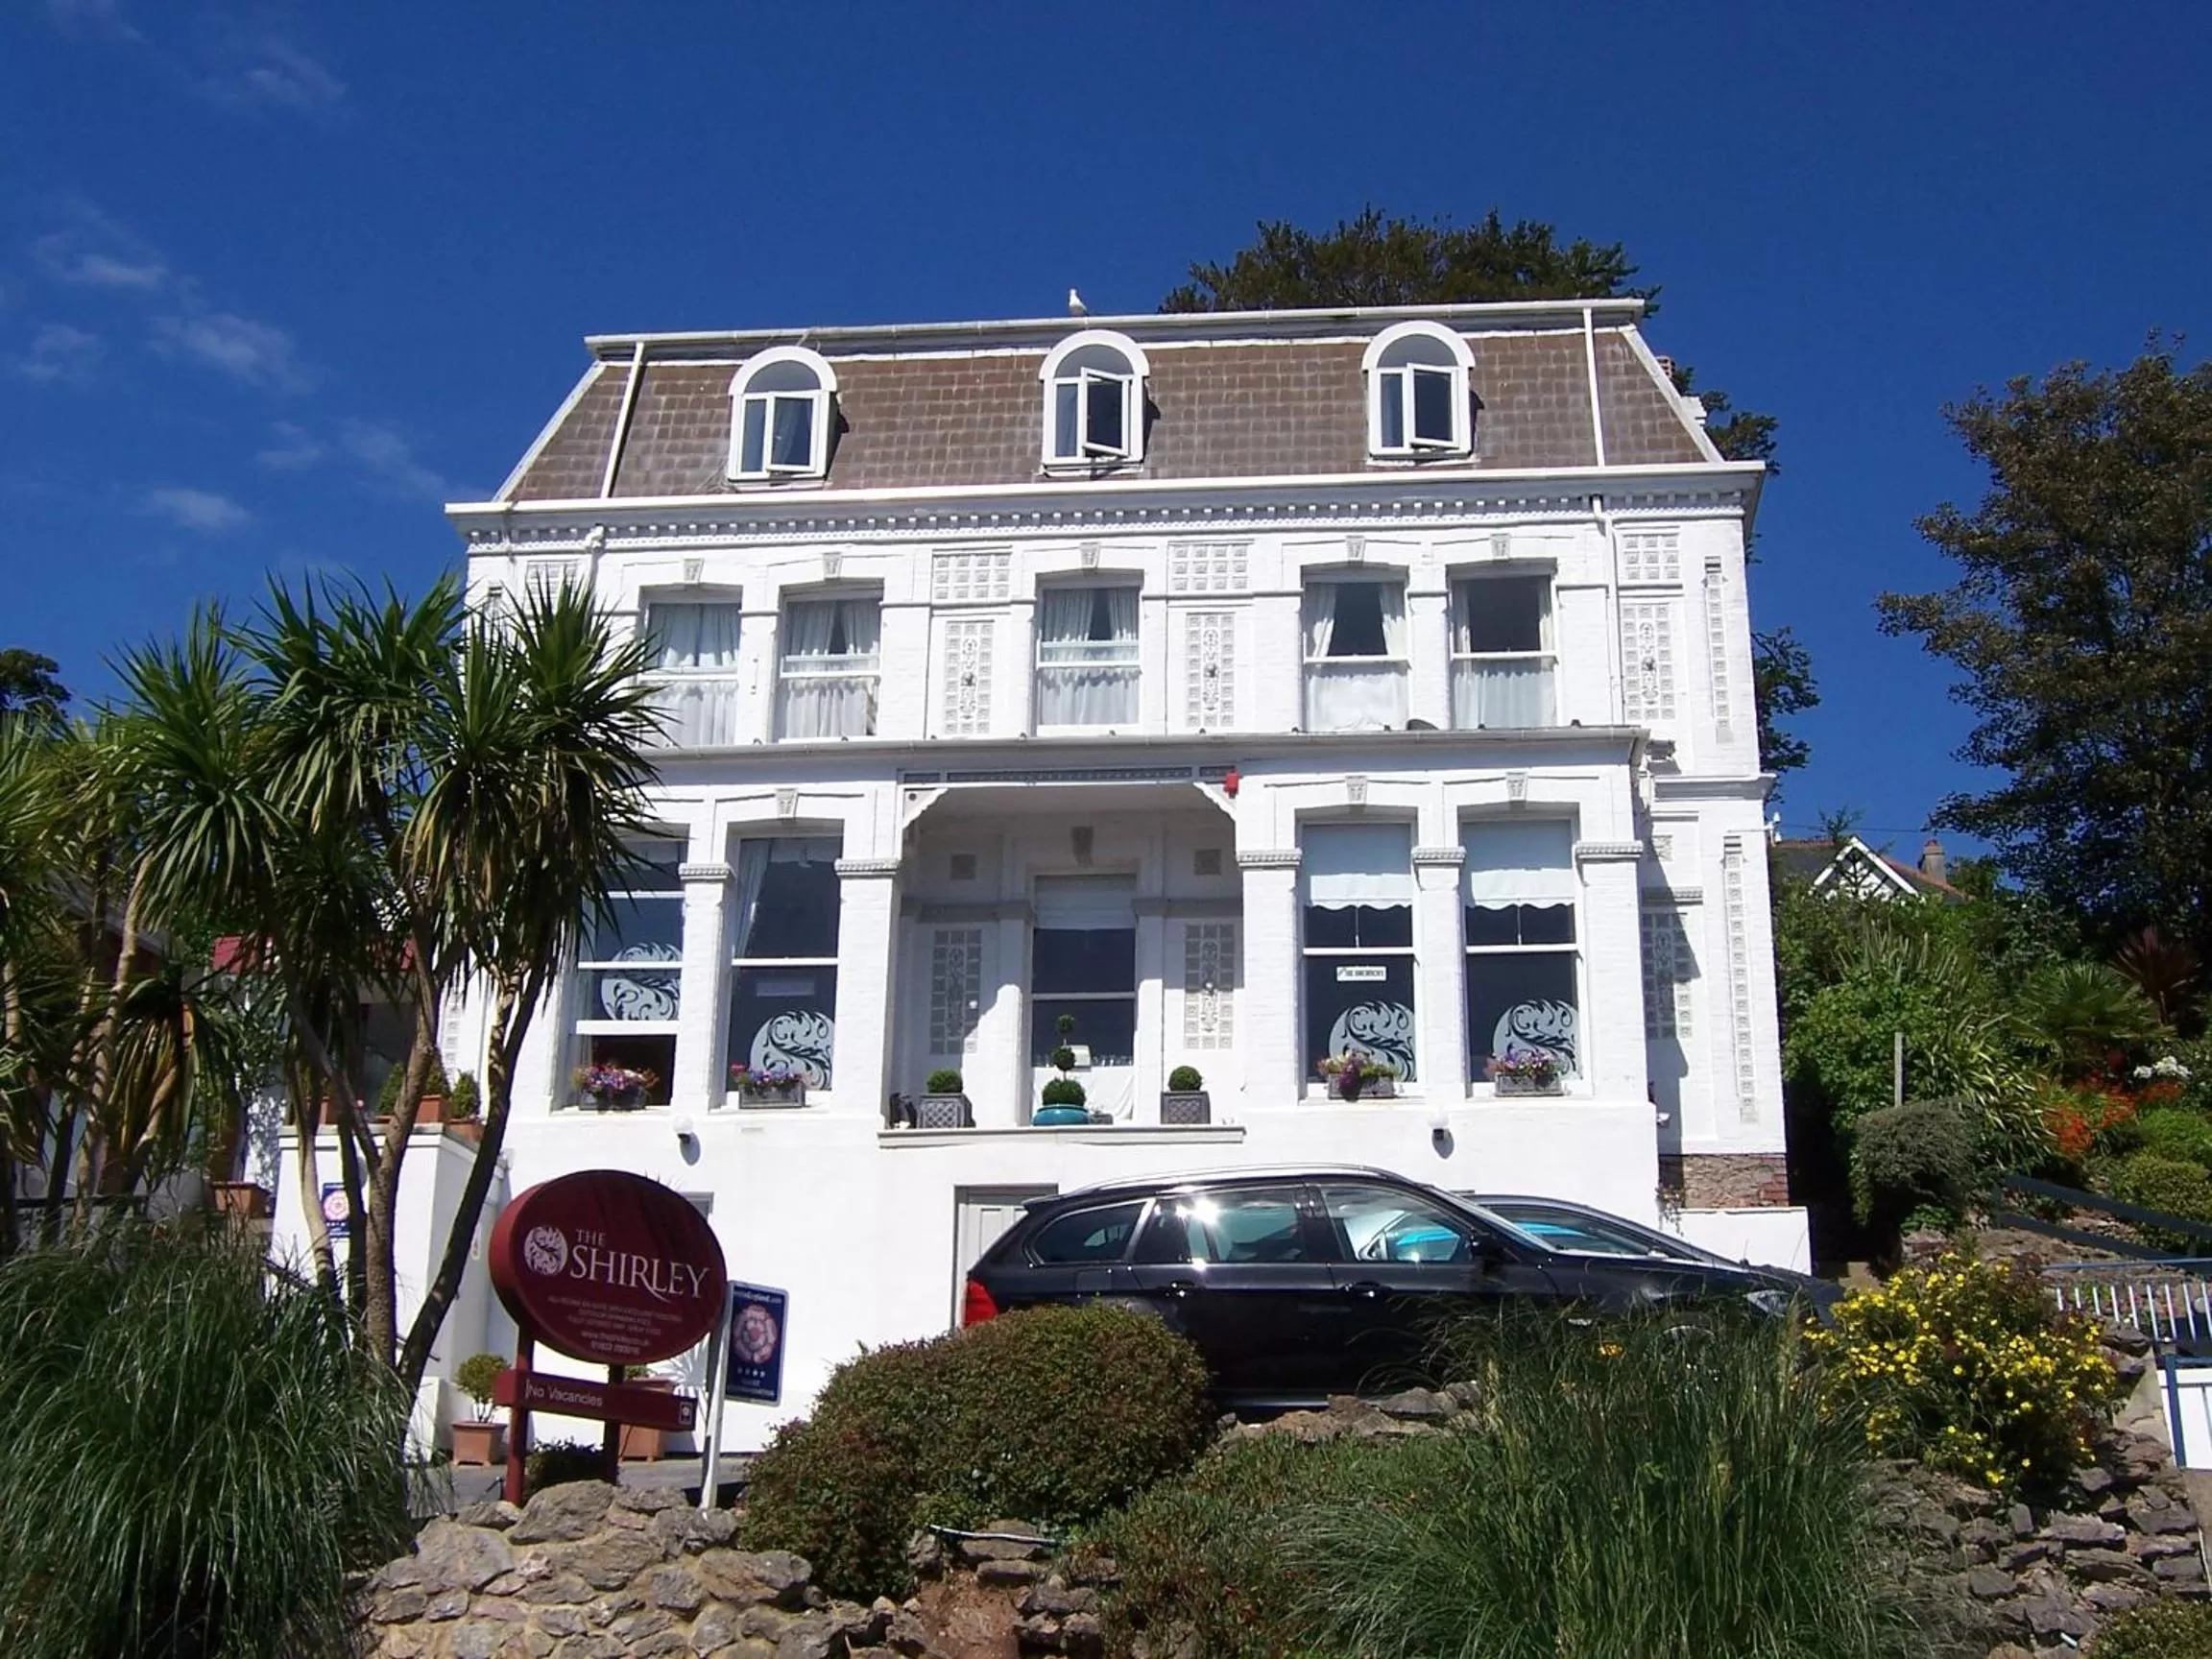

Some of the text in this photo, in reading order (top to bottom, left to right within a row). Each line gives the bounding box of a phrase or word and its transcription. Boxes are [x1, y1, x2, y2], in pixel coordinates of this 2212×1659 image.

[576, 1229, 606, 1246] THE
[569, 1244, 710, 1303] SHIRLEY
[528, 1383, 604, 1407] No Vacancies
